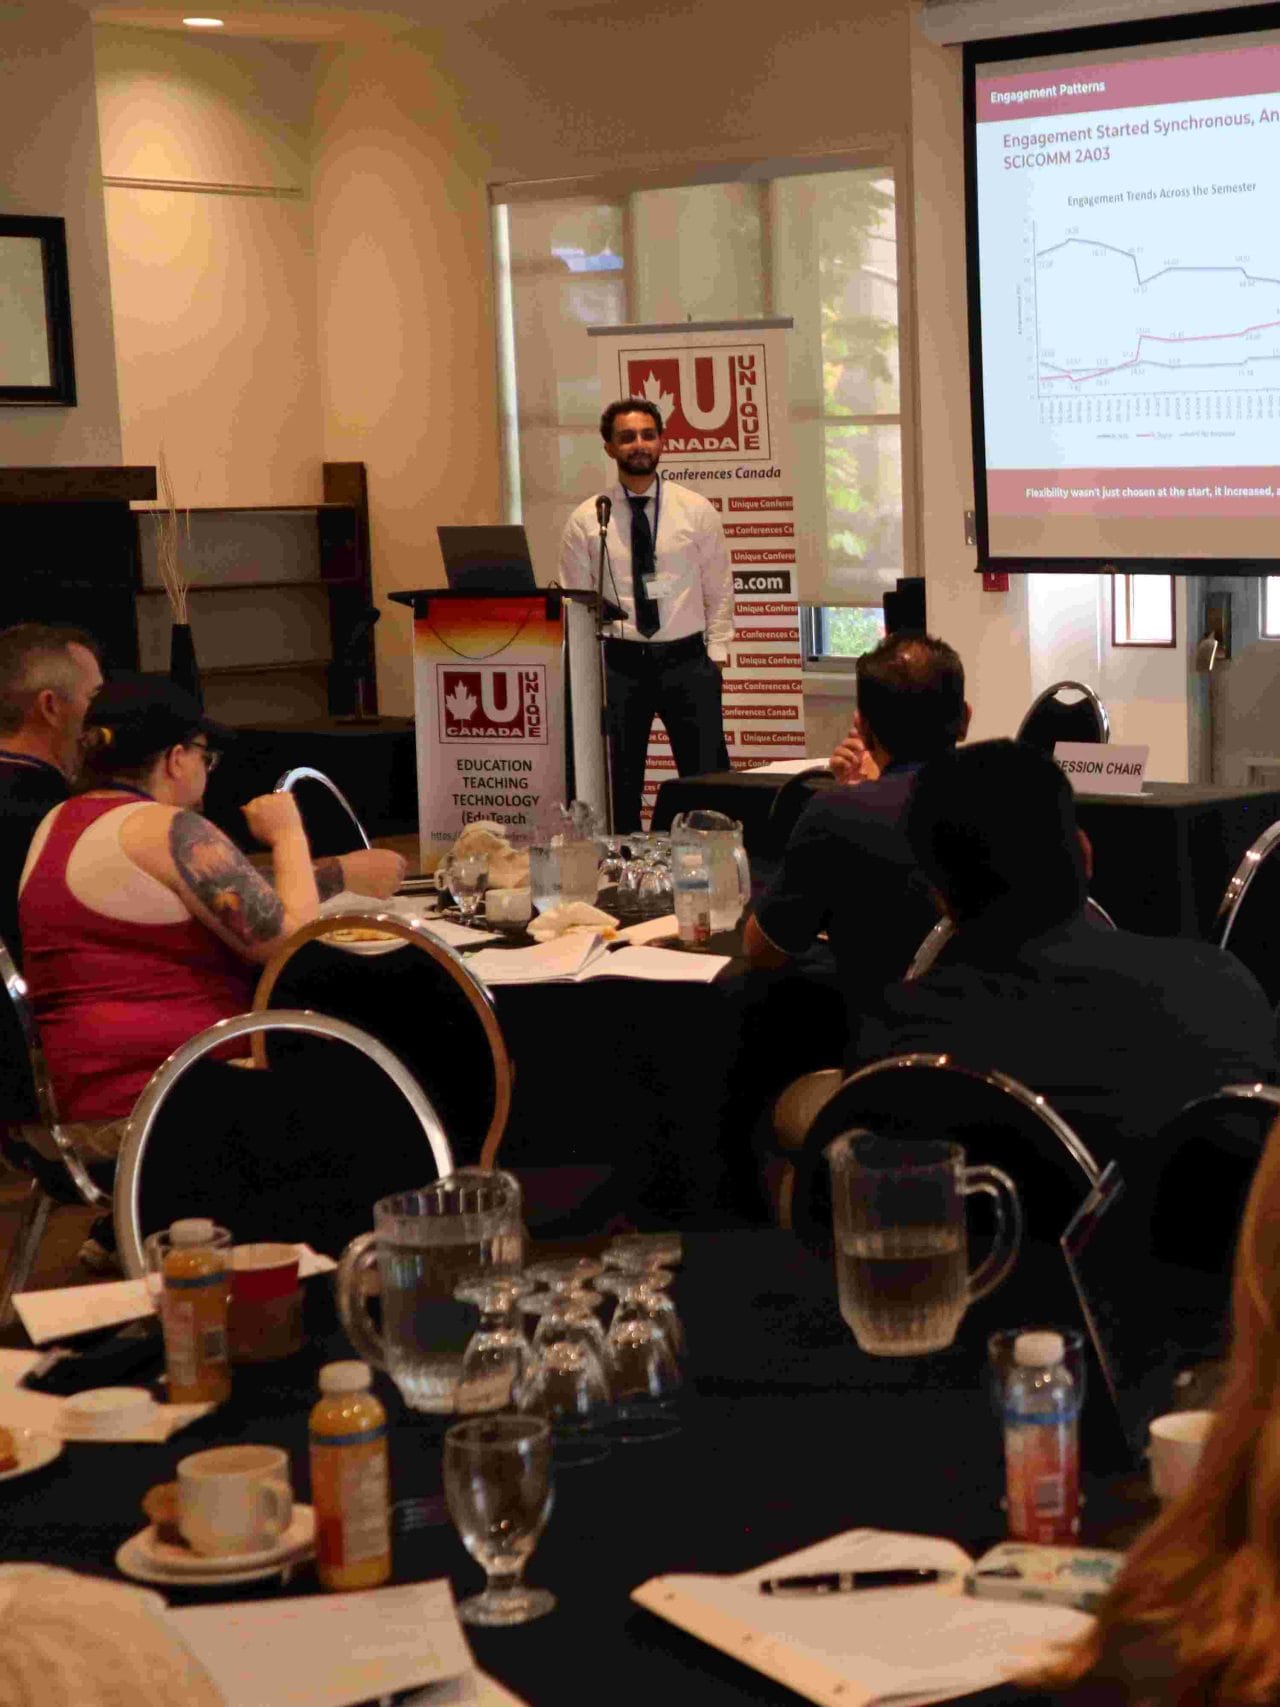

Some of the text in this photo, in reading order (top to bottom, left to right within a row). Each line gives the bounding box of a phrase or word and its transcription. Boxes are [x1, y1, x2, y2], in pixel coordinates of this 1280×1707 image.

[990, 80, 1106, 104] Engagement Patterns
[1003, 126, 1093, 150] Engagement
[1096, 120, 1149, 140] Started
[1153, 112, 1255, 136] Synchronous,
[1004, 147, 1111, 170] SCICOMM 2A03
[1067, 181, 1257, 208] Engagement Trends Across the Semester
[737, 354, 760, 451] UNIQUE
[662, 436, 738, 452] NADA
[661, 465, 781, 480] Conferences Canada
[1025, 487, 1069, 499] Flexibility
[1071, 487, 1101, 498] wasn't
[1101, 486, 1120, 499] just
[1122, 486, 1155, 497] chosen
[1157, 487, 1167, 497] at
[1169, 486, 1185, 497] the
[1187, 486, 1212, 498] start,
[1214, 486, 1222, 496] it
[1224, 486, 1274, 498] increased,
[731, 499, 759, 510] Unique
[736, 525, 782, 534] Conferences
[734, 552, 761, 562] Unique
[736, 604, 764, 614] Unique
[741, 629, 788, 639] Conferences
[739, 655, 767, 665] Unique
[744, 682, 790, 692] Conferences
[524, 671, 541, 738] UNIQUE
[767, 707, 796, 716] Canada
[446, 726, 523, 737] CANADA
[743, 734, 770, 743] Unique
[456, 759, 532, 772] EDUCATION
[1106, 761, 1142, 775] CHAIR
[463, 776, 528, 789] TEACHING
[452, 793, 540, 807] TECHNOLOGY
